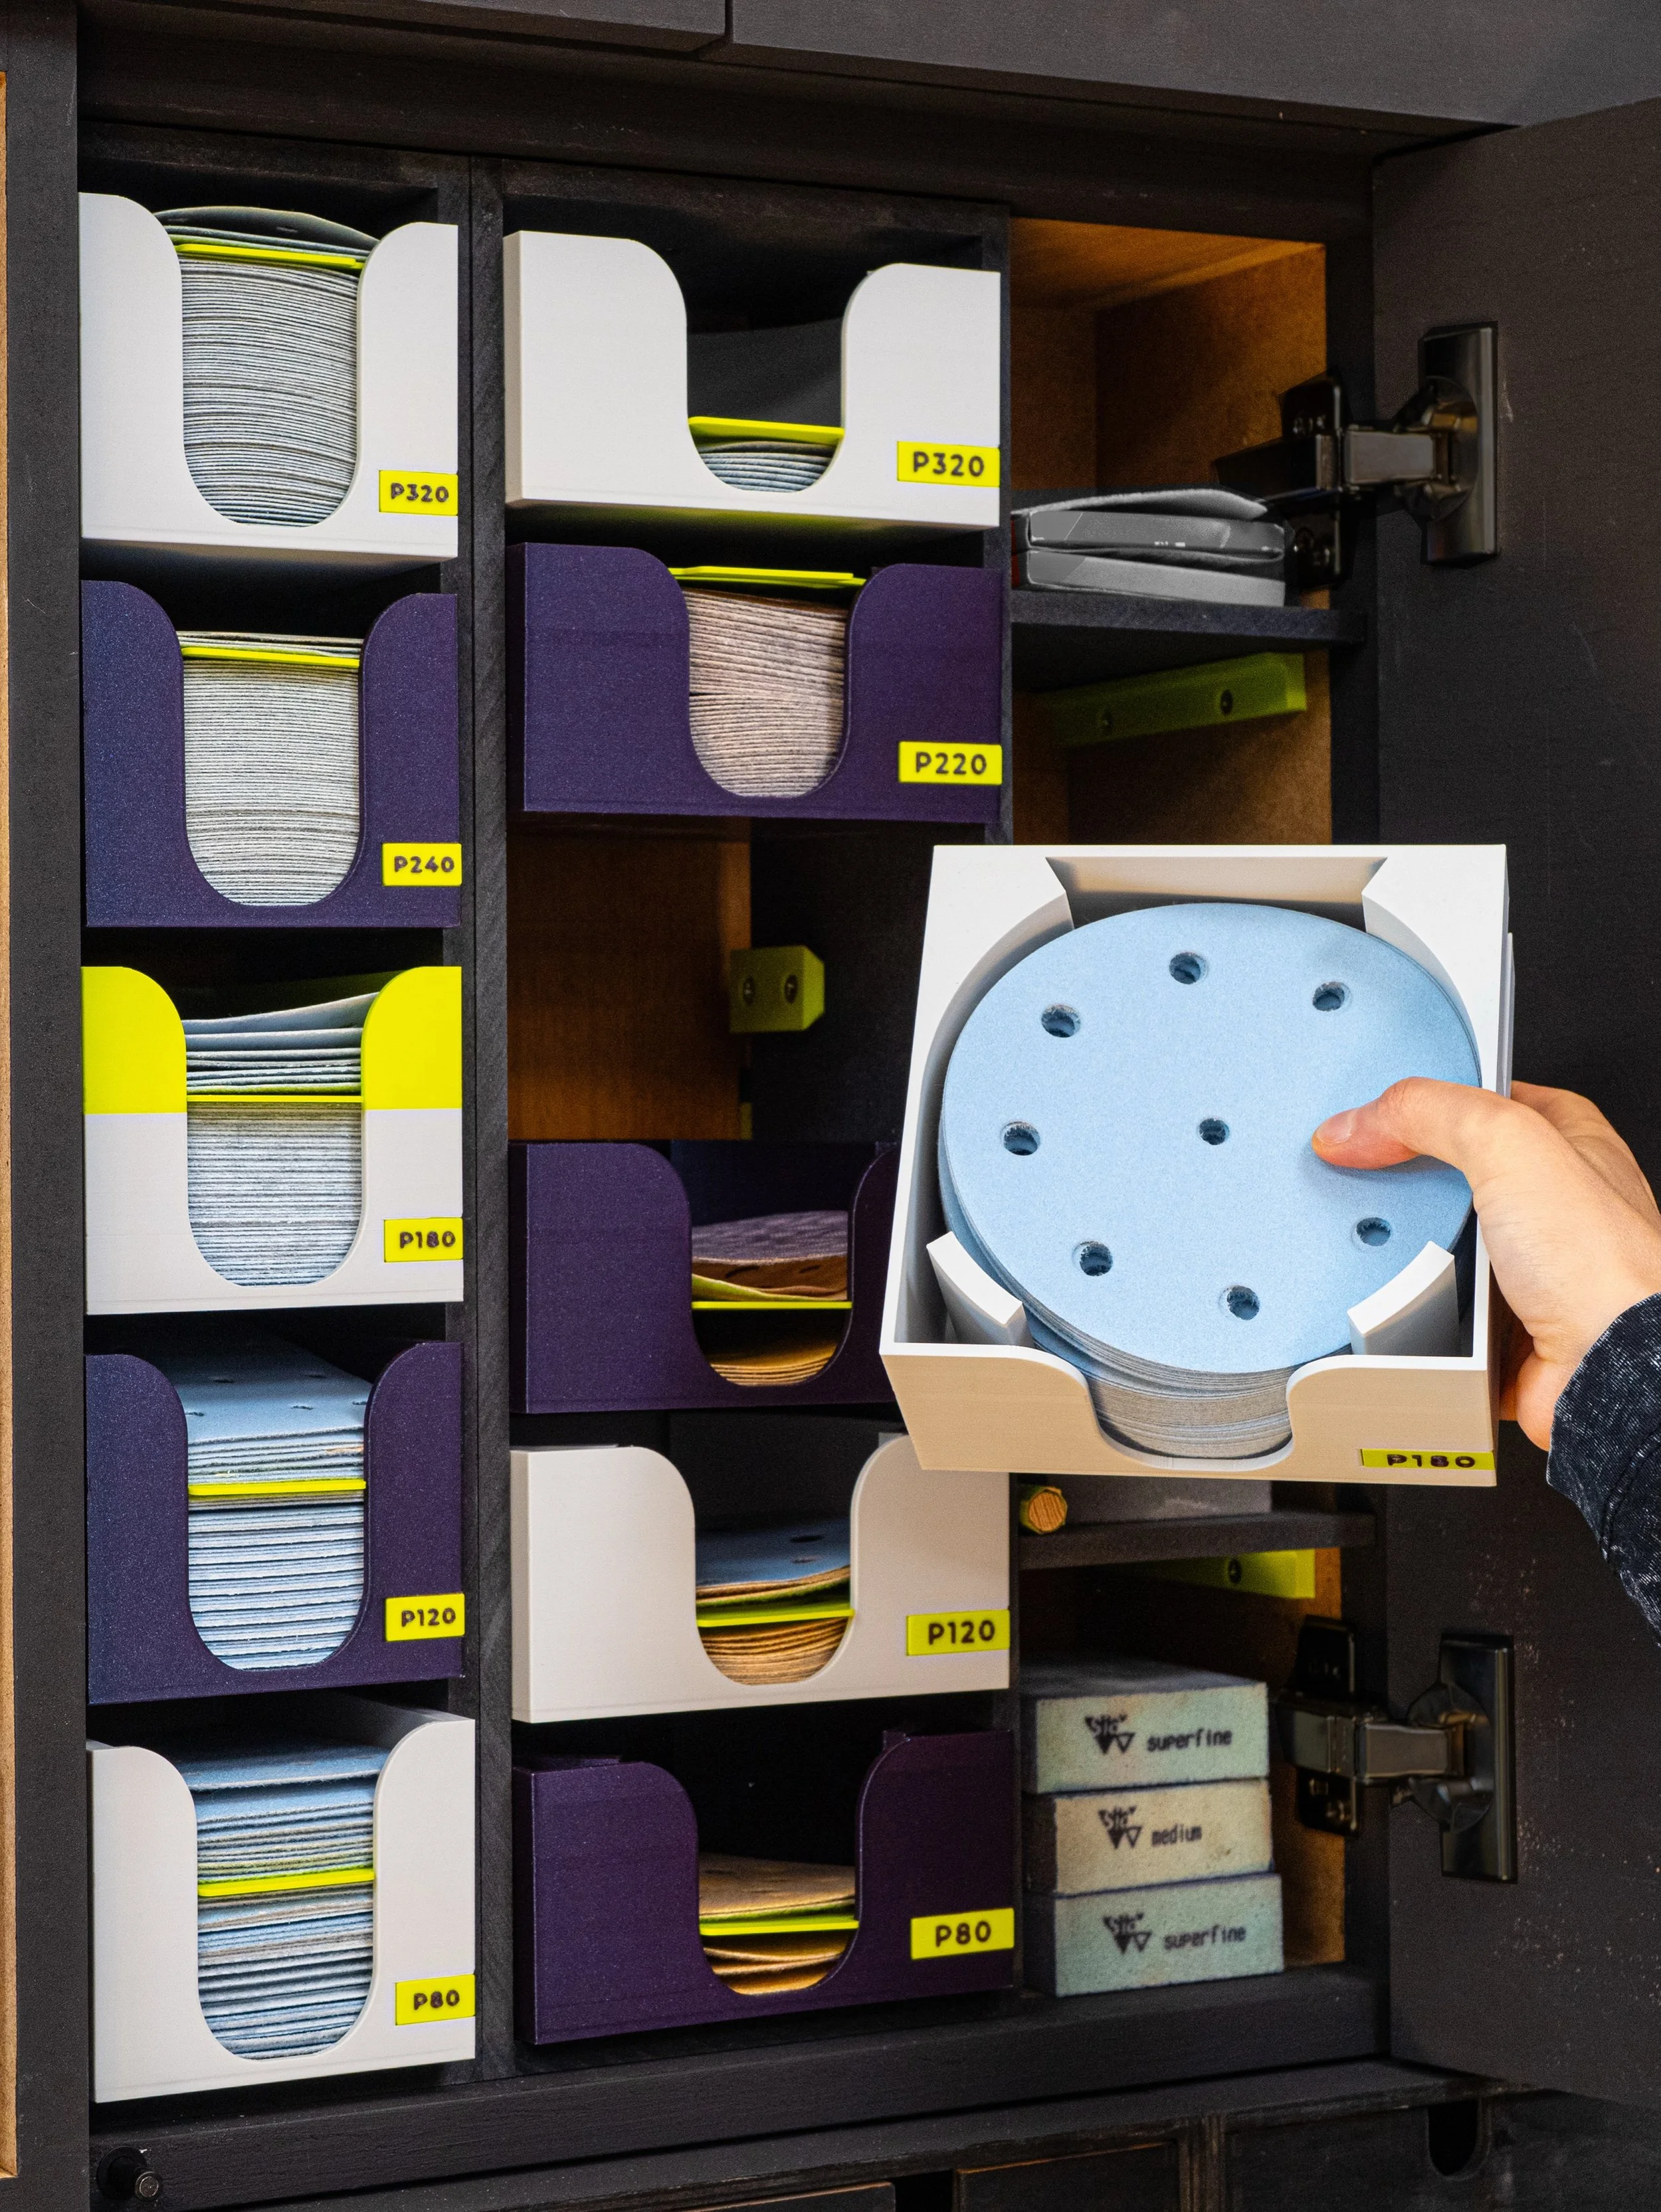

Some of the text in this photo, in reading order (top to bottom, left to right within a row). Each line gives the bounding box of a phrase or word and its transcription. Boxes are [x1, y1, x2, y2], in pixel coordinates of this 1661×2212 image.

[914, 452, 985, 478] P320
[391, 483, 448, 503] P320
[916, 752, 987, 775] P220
[393, 855, 456, 874] P240
[399, 1230, 455, 1249] P180
[1387, 1453, 1476, 1468] P180
[401, 1608, 456, 1627] P120
[929, 1619, 996, 1645] P120
[1147, 1728, 1232, 1752] superfine
[1151, 1824, 1202, 1847] medium
[935, 1920, 992, 1947] P80
[1164, 1924, 1246, 1950] superfine
[414, 1989, 460, 2010] P80
